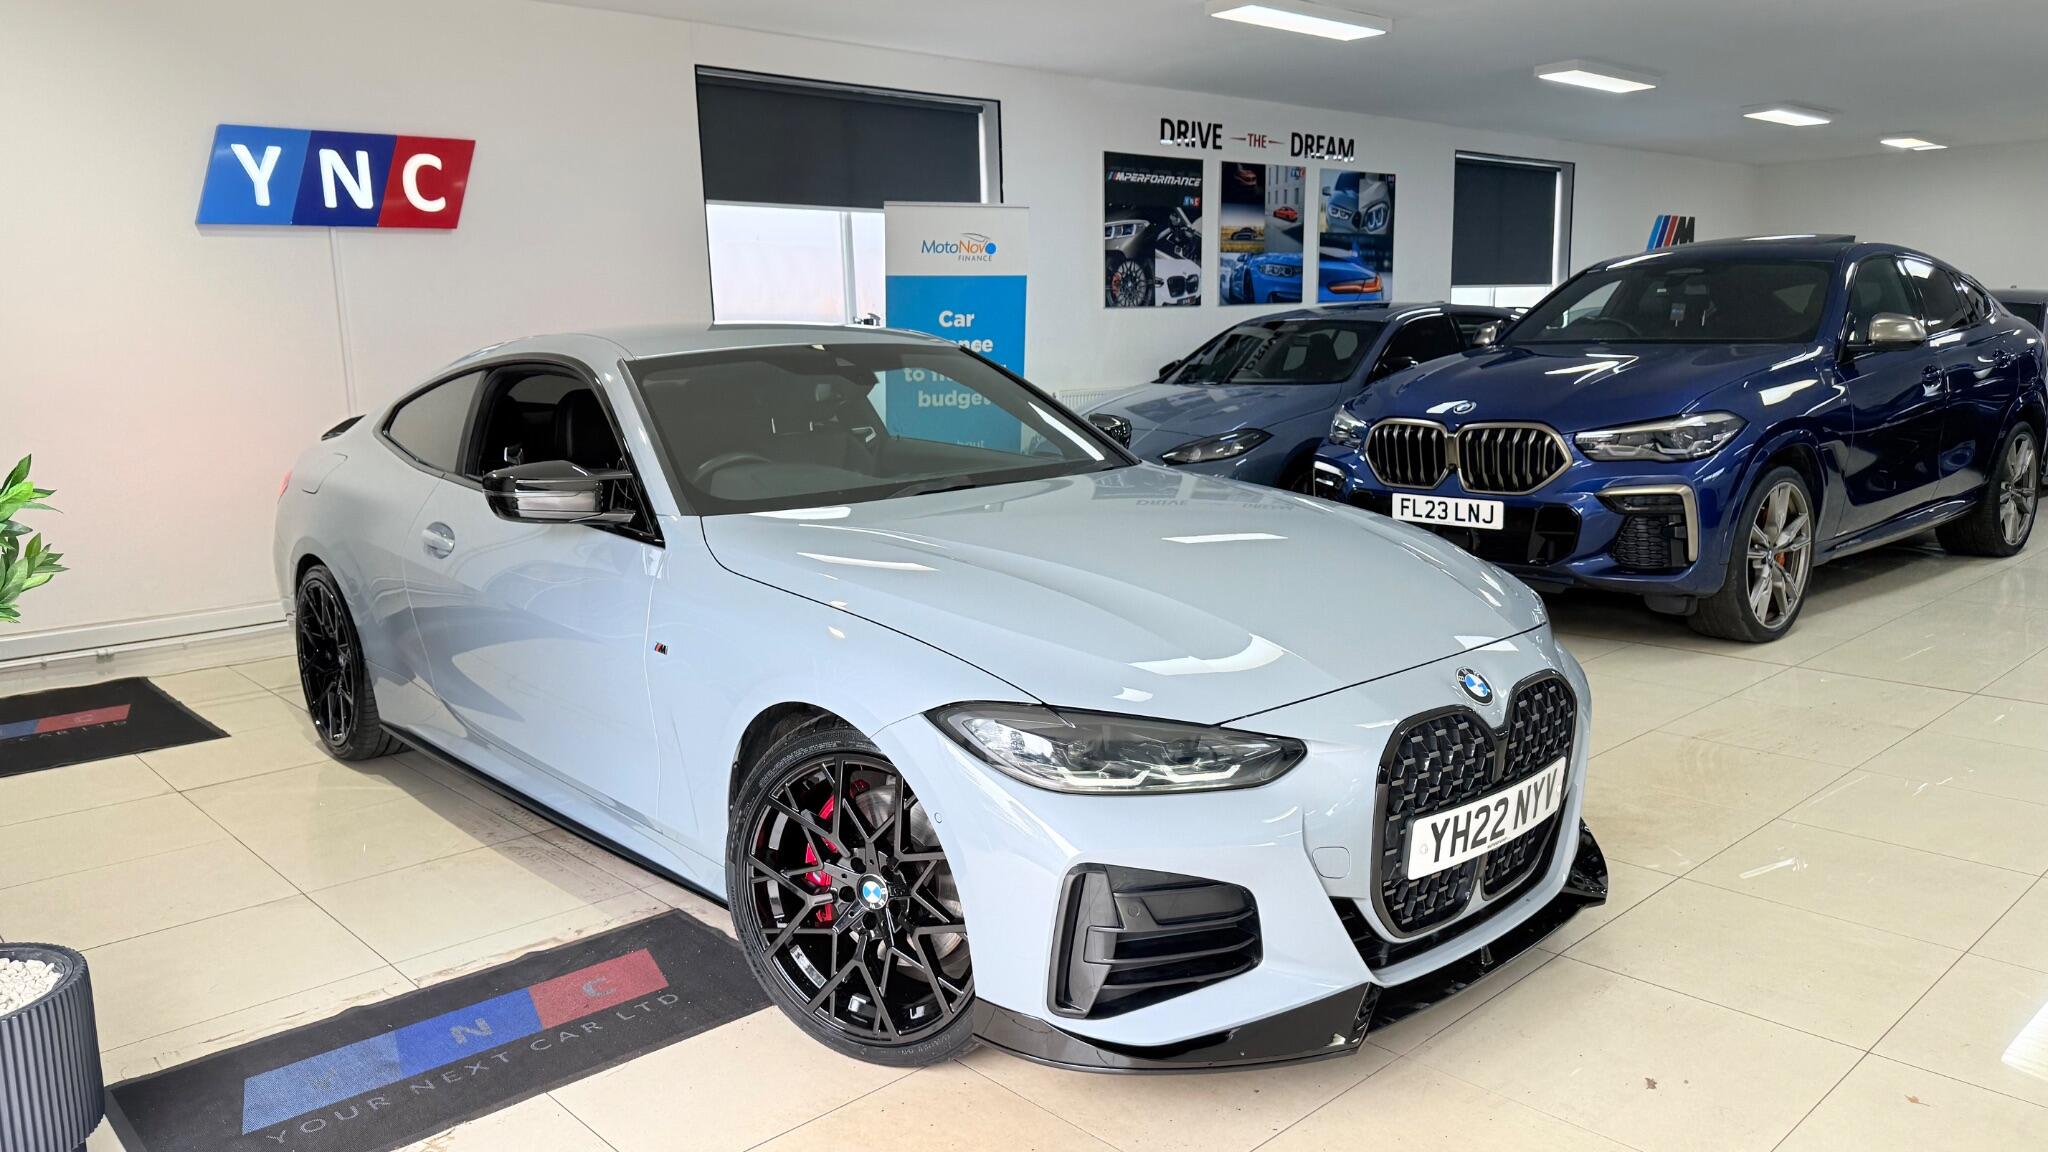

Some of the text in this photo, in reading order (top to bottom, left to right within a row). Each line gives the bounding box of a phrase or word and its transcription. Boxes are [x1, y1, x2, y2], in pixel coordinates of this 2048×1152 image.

[1160, 118, 1355, 162] DRIVE THE DREAM
[231, 143, 447, 213] YNC
[958, 254, 993, 262] FINANCE
[938, 310, 975, 328] Car
[904, 368, 926, 382] to
[1400, 498, 1494, 524] FL23 LNJ
[1430, 767, 1558, 863] YH22 NYV
[266, 993, 679, 1144] YOUR NEXT CAR LTD
